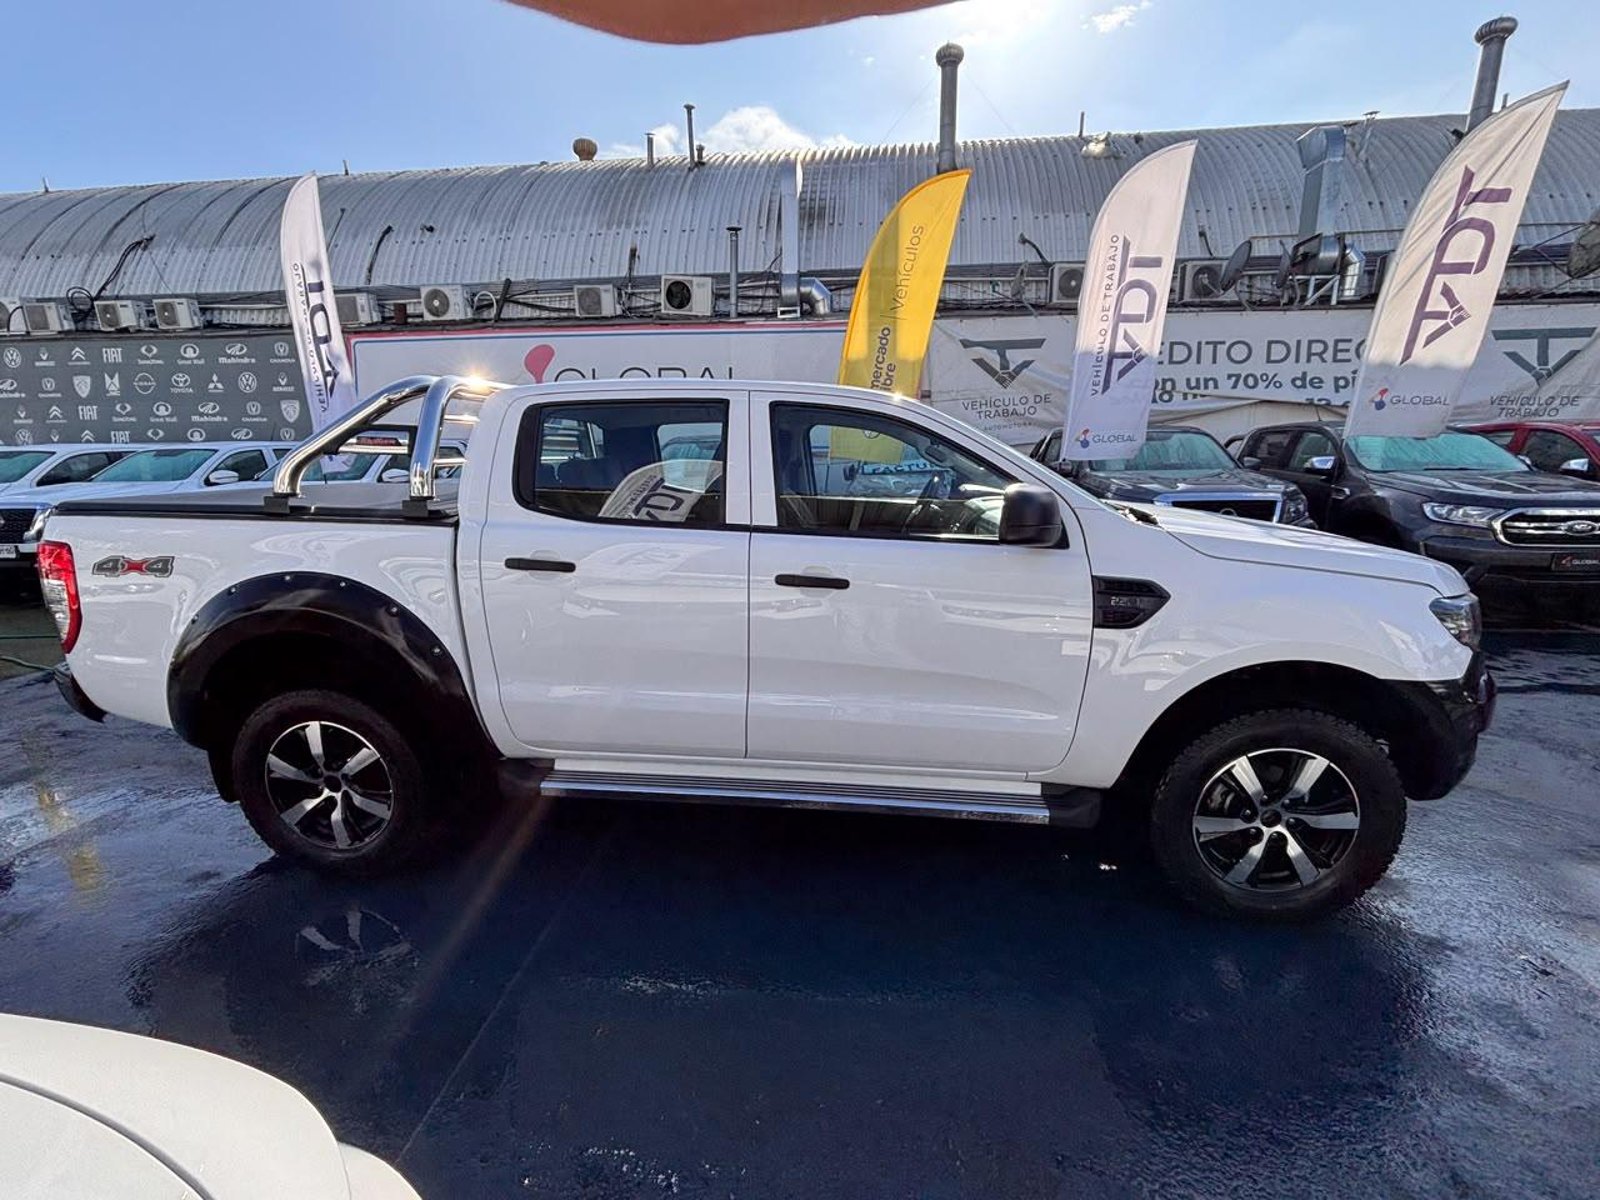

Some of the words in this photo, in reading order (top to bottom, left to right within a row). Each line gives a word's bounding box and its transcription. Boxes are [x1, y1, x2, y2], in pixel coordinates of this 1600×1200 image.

[890, 225, 924, 311] Vehículos
[1103, 234, 1120, 299] TRABAJO
[1100, 304, 1112, 322] DE
[102, 348, 122, 363] FIAT
[1090, 330, 1108, 396] VEHÍCULO
[1186, 376, 1210, 390] un
[1227, 372, 1283, 390] 70%
[1291, 371, 1324, 389] de
[962, 395, 1028, 411] VEHÍCULO
[1034, 394, 1052, 405] DE
[1390, 395, 1450, 406] GLOBAL
[1490, 395, 1556, 407] VEHÍCULO
[1559, 395, 1580, 407] DE
[78, 405, 98, 421] FIAT
[976, 406, 1037, 419] TRABAJO
[1498, 407, 1560, 418] TRABAJO
[1092, 434, 1138, 444] GLOBAL
